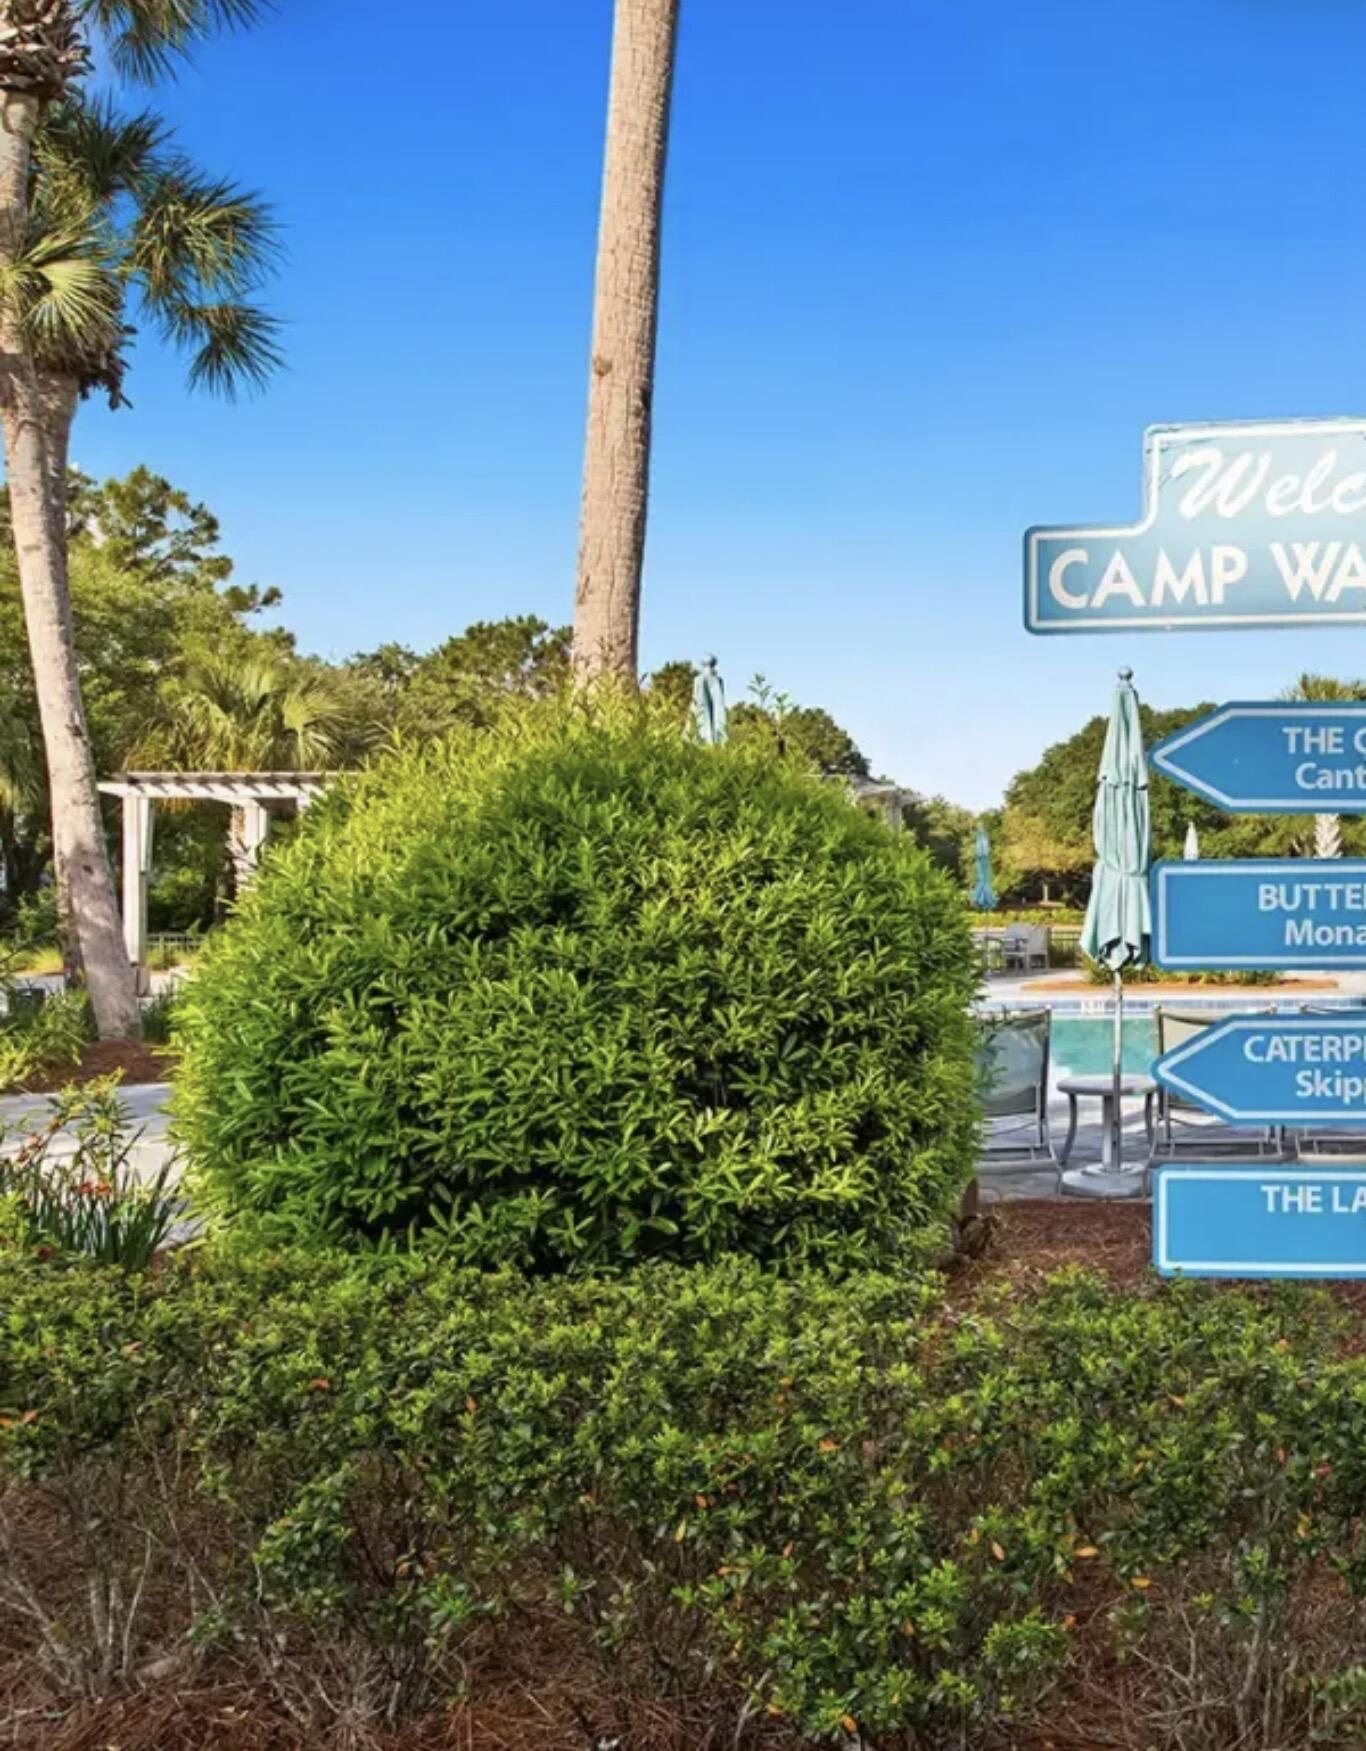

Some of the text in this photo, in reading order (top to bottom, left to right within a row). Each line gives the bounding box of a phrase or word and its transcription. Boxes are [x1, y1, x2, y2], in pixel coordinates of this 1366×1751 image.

[1048, 544, 1247, 609] CAMP
[1282, 728, 1344, 754] THE
[1261, 1186, 1323, 1213] THE
